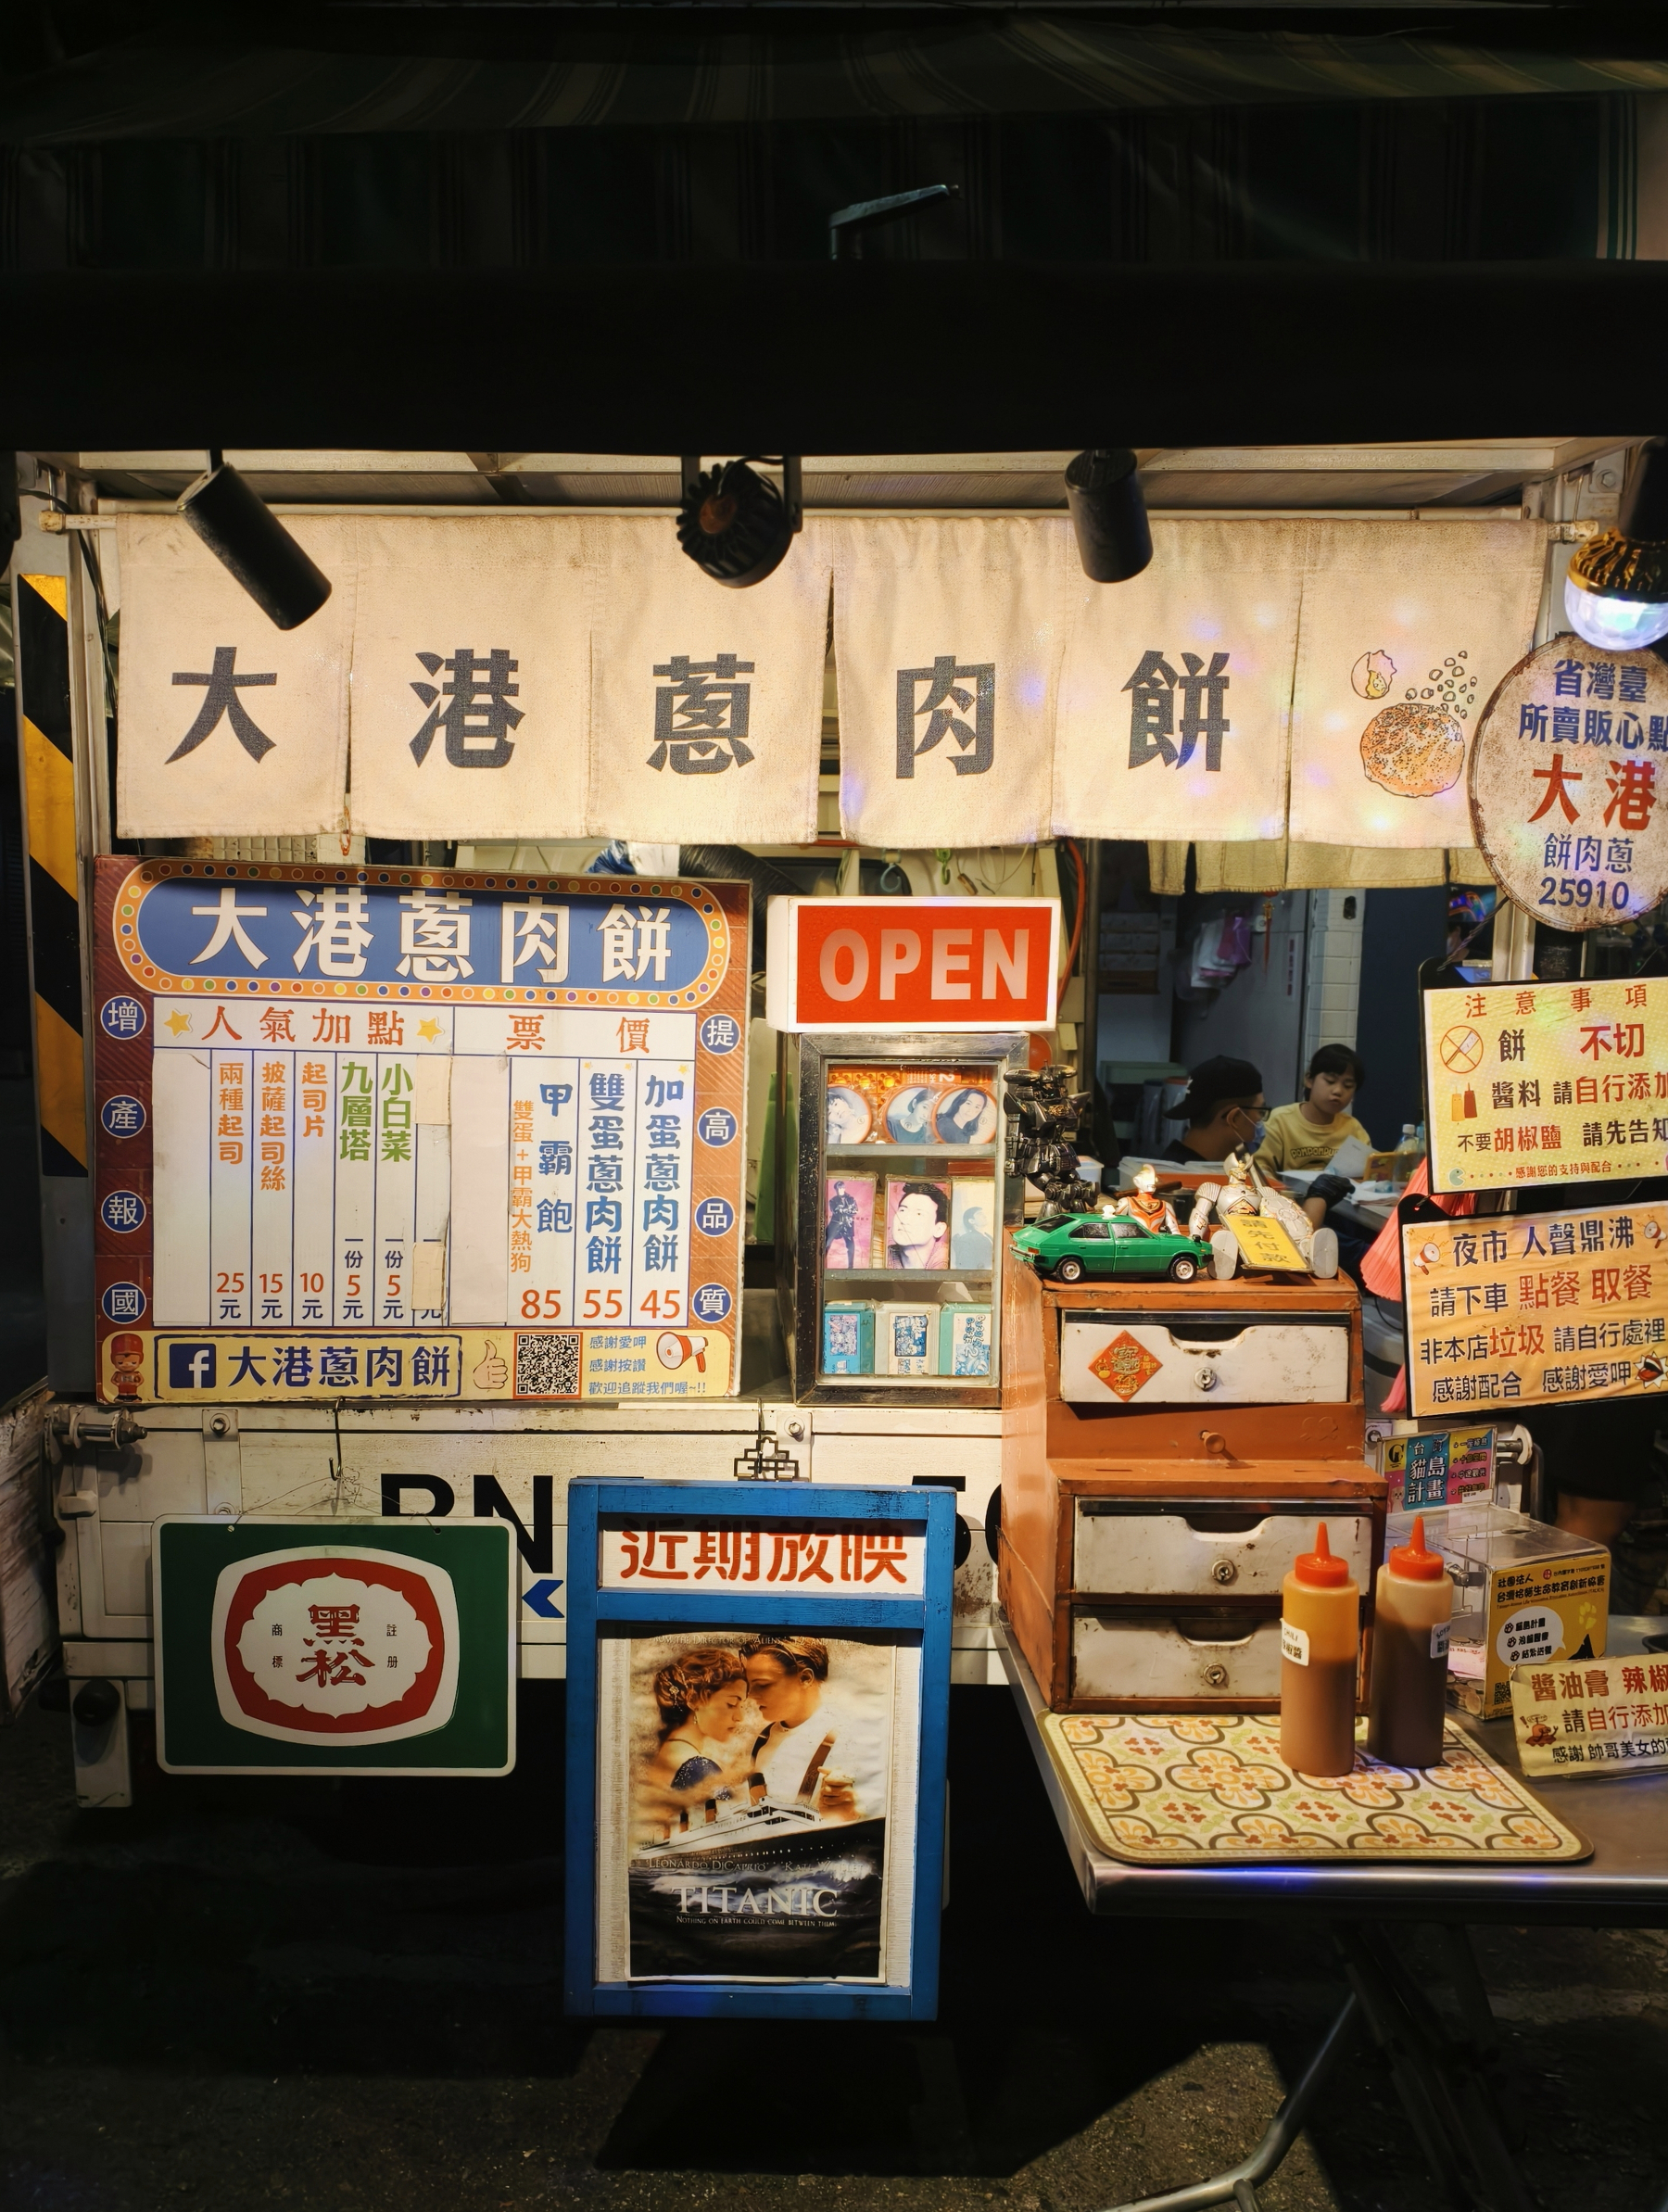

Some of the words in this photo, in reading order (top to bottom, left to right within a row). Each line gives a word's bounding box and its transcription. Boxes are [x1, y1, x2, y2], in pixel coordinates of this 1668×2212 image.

[164, 647, 1231, 779] 大港蔥肉餅
[1538, 877, 1629, 910] 25910
[188, 887, 672, 983] 大港蔥肉餅
[819, 929, 1030, 1002] OPEN
[1465, 984, 1647, 1018] 注意事項
[201, 1006, 405, 1045] 人氣加點
[507, 1014, 650, 1054] 票價
[1498, 1029, 1525, 1062] 餅
[1580, 1023, 1646, 1061] 不切
[218, 1062, 245, 1165] 兩種起司
[301, 1062, 329, 1138] 起司片
[339, 1061, 373, 1162] 九層塔
[381, 1063, 414, 1162] 小白菜
[1492, 1080, 1541, 1109] 醬料
[259, 1061, 286, 1192] 披薩起司絲
[1458, 1125, 1561, 1153] 不要胡椒鹽
[537, 1083, 573, 1233] 甲霸飽
[586, 1073, 626, 1274] 雙蛋蔥肉餅
[642, 1075, 684, 1272] 加蛋蔥肉餅
[1515, 1161, 1611, 1179] 感謝您的支持與配合
[1453, 1231, 1508, 1267] 夜市
[1522, 1216, 1634, 1259] 人聲鼎沸
[521, 1289, 562, 1320] 85
[583, 1289, 623, 1319] 55
[640, 1289, 681, 1320] 45
[1430, 1283, 1509, 1318] 請下車
[1519, 1270, 1581, 1310] 點餐
[1591, 1264, 1653, 1303] 取餐
[589, 1335, 647, 1350] 感謝愛呷
[1420, 1324, 1546, 1365] 非本店垃圾
[1553, 1317, 1666, 1354] 請自行處裡
[228, 1346, 449, 1387] 大港蔥肉餅
[589, 1359, 646, 1372] 感謝按讚
[1433, 1371, 1522, 1403] 感謝配合
[1542, 1360, 1631, 1393] 感謝愛呷
[1409, 1456, 1446, 1480] 貓島
[1408, 1479, 1444, 1504] 計畫
[620, 1518, 908, 1584] 近期放映
[272, 1624, 284, 1669] 商標
[296, 1603, 375, 1687] 黑松
[693, 1635, 735, 1645] DIRECTOR
[1532, 1669, 1610, 1702] 醬油膏
[1552, 1745, 1584, 1763] 感謝
[1589, 1736, 1668, 1761] 帥哥美女的
[649, 1859, 708, 1870] LEONARDO
[671, 1886, 839, 1918] TITANIC
[676, 1915, 706, 1925] NOTHING
[743, 1917, 765, 1926] COULD
